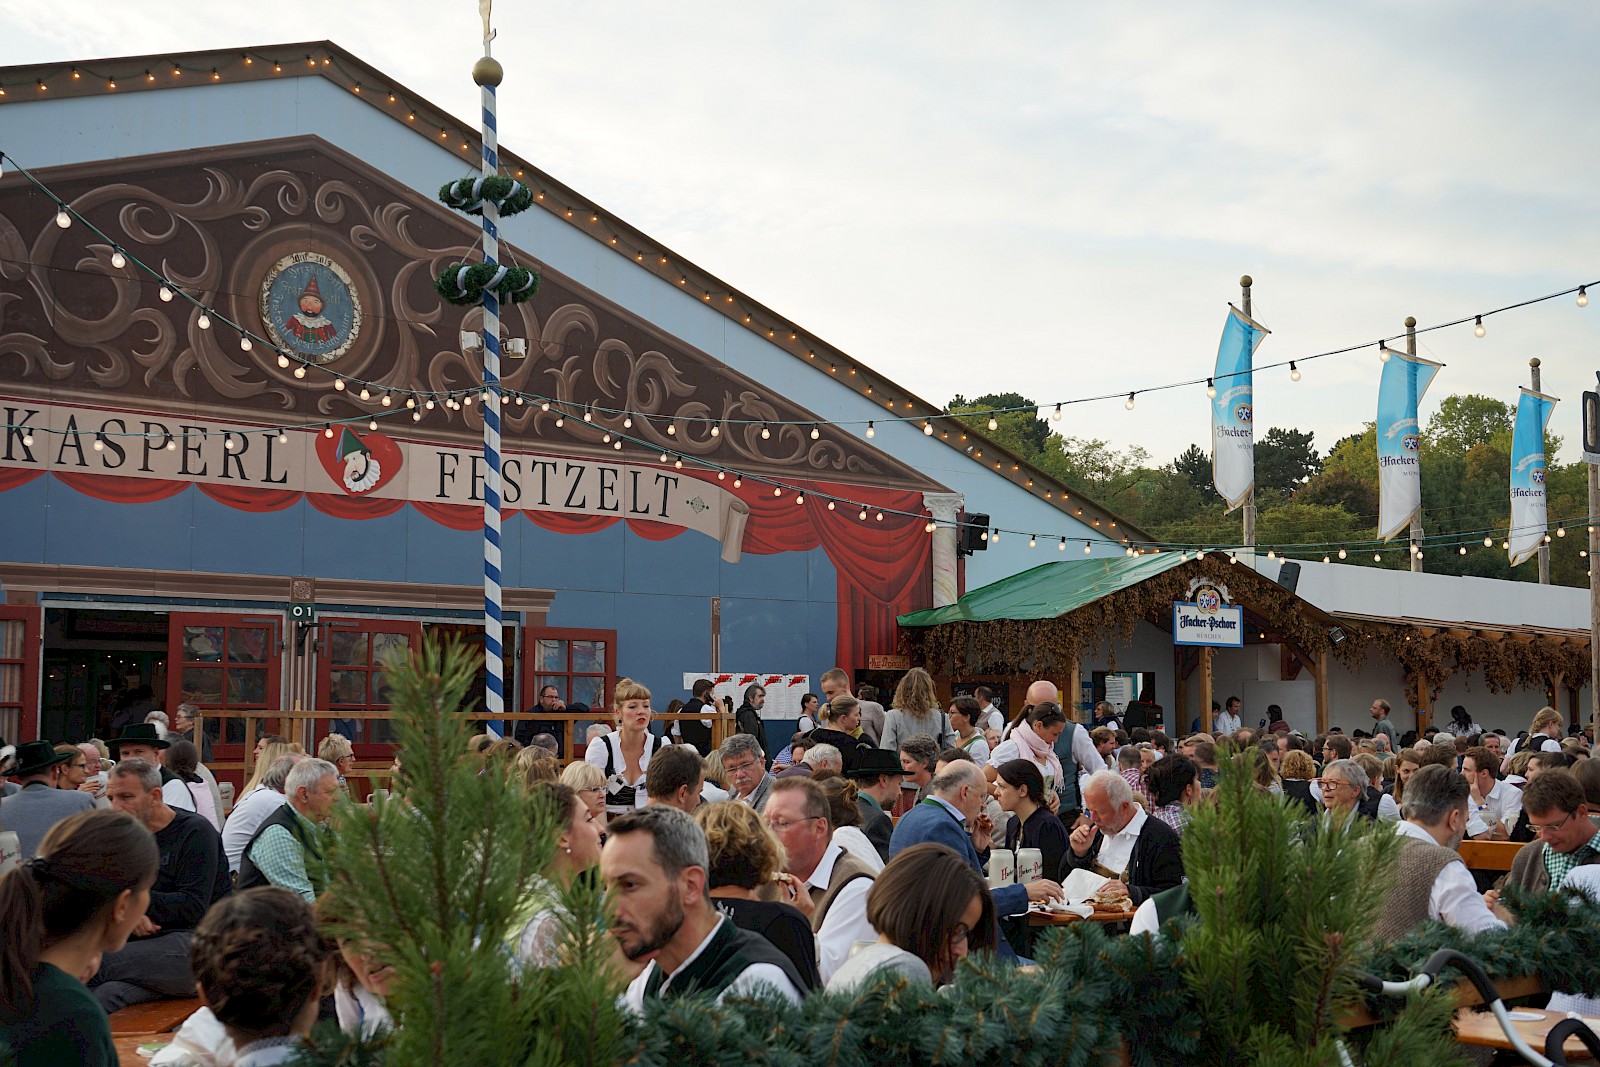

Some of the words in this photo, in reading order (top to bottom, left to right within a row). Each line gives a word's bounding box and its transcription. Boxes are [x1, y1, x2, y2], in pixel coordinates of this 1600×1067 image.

[1, 407, 288, 484] KASPERL
[435, 451, 679, 518] FESTZELT
[1380, 455, 1420, 468] Hacker-
[1511, 487, 1546, 499] Hacker-
[1180, 615, 1236, 631] Hacker-Pschorr
